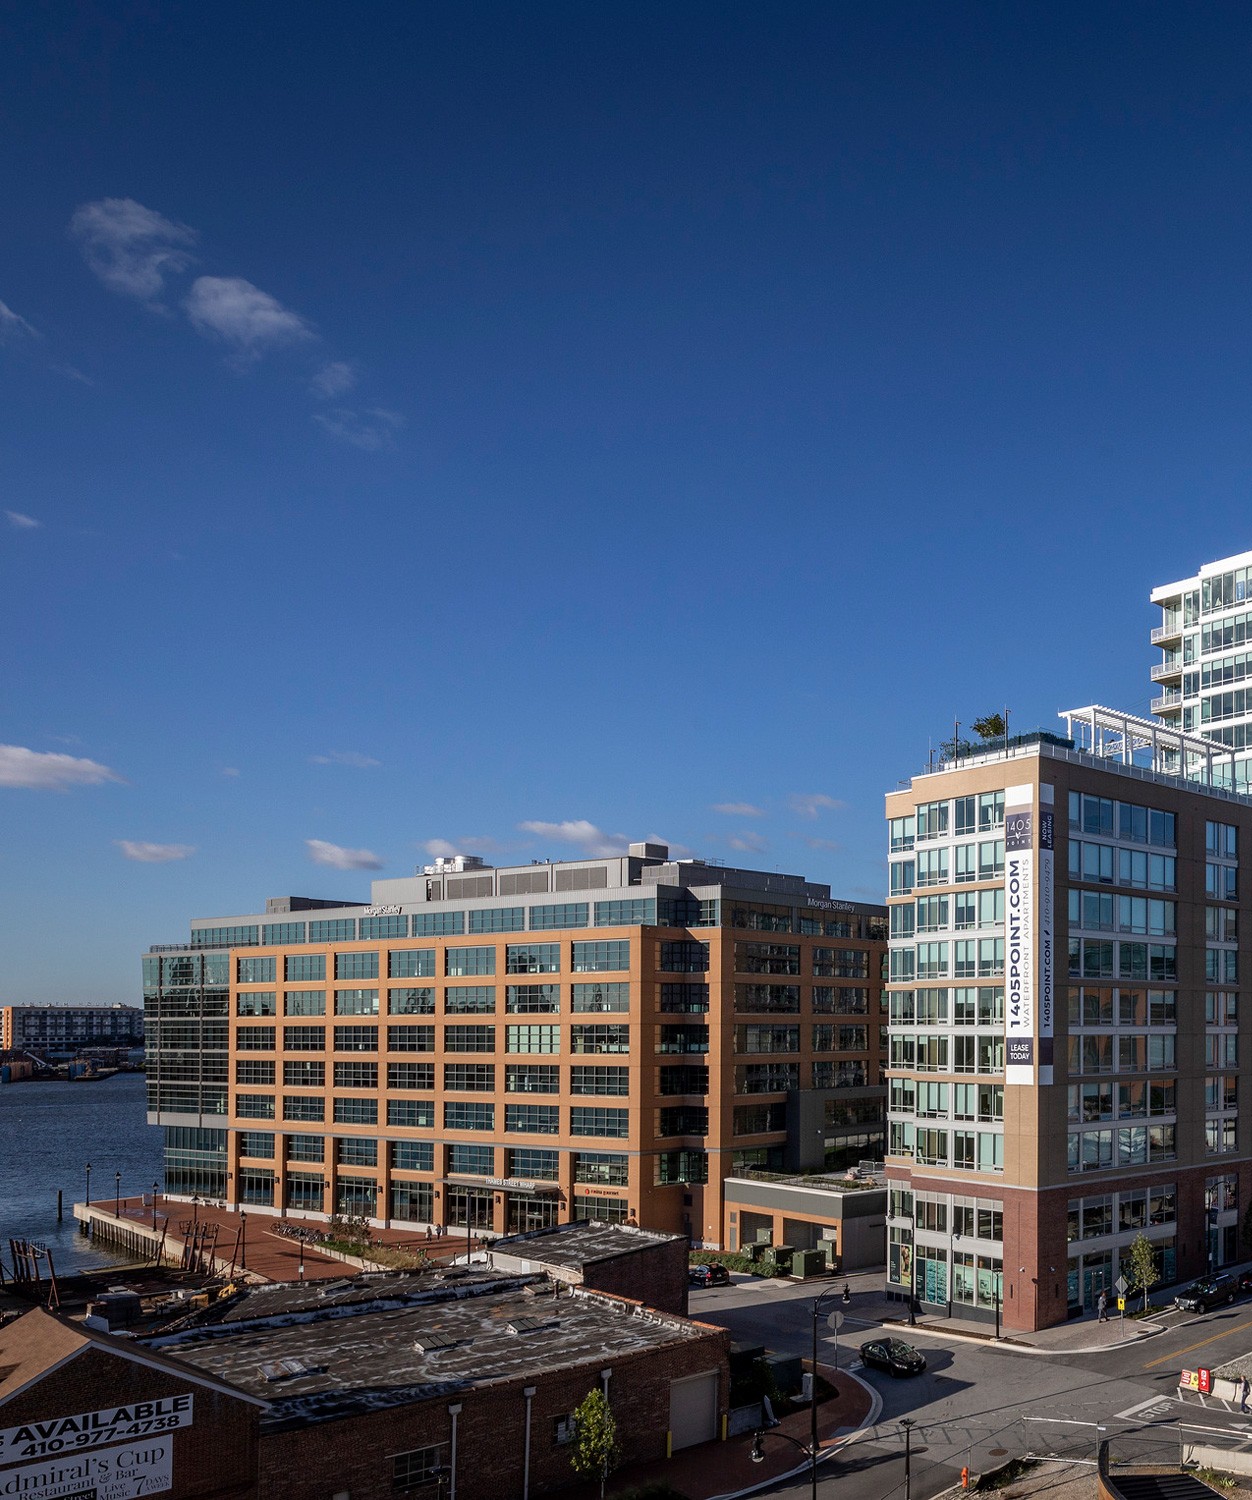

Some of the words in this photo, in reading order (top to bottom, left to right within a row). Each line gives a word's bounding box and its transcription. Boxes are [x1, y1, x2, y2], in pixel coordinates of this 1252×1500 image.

[1007, 818, 1031, 832] 1405
[807, 898, 832, 909] Morgan
[832, 901, 855, 913] Stanley
[1022, 858, 1030, 939] APARTMENTS
[1010, 860, 1021, 1028] 1405POINT.COM
[1138, 1402, 1174, 1418] STOP
[10, 1396, 190, 1445] AVAILABLE
[20, 1415, 180, 1456] 410-977-4738
[116, 1447, 165, 1468] Cup
[19, 1477, 95, 1500] Restaurant
[98, 1472, 113, 1483] &
[116, 1467, 139, 1480] Bar
[104, 1481, 126, 1493] Live
[132, 1475, 147, 1495] 7
[145, 1474, 170, 1487] DAYS
[100, 1489, 131, 1500] Music
